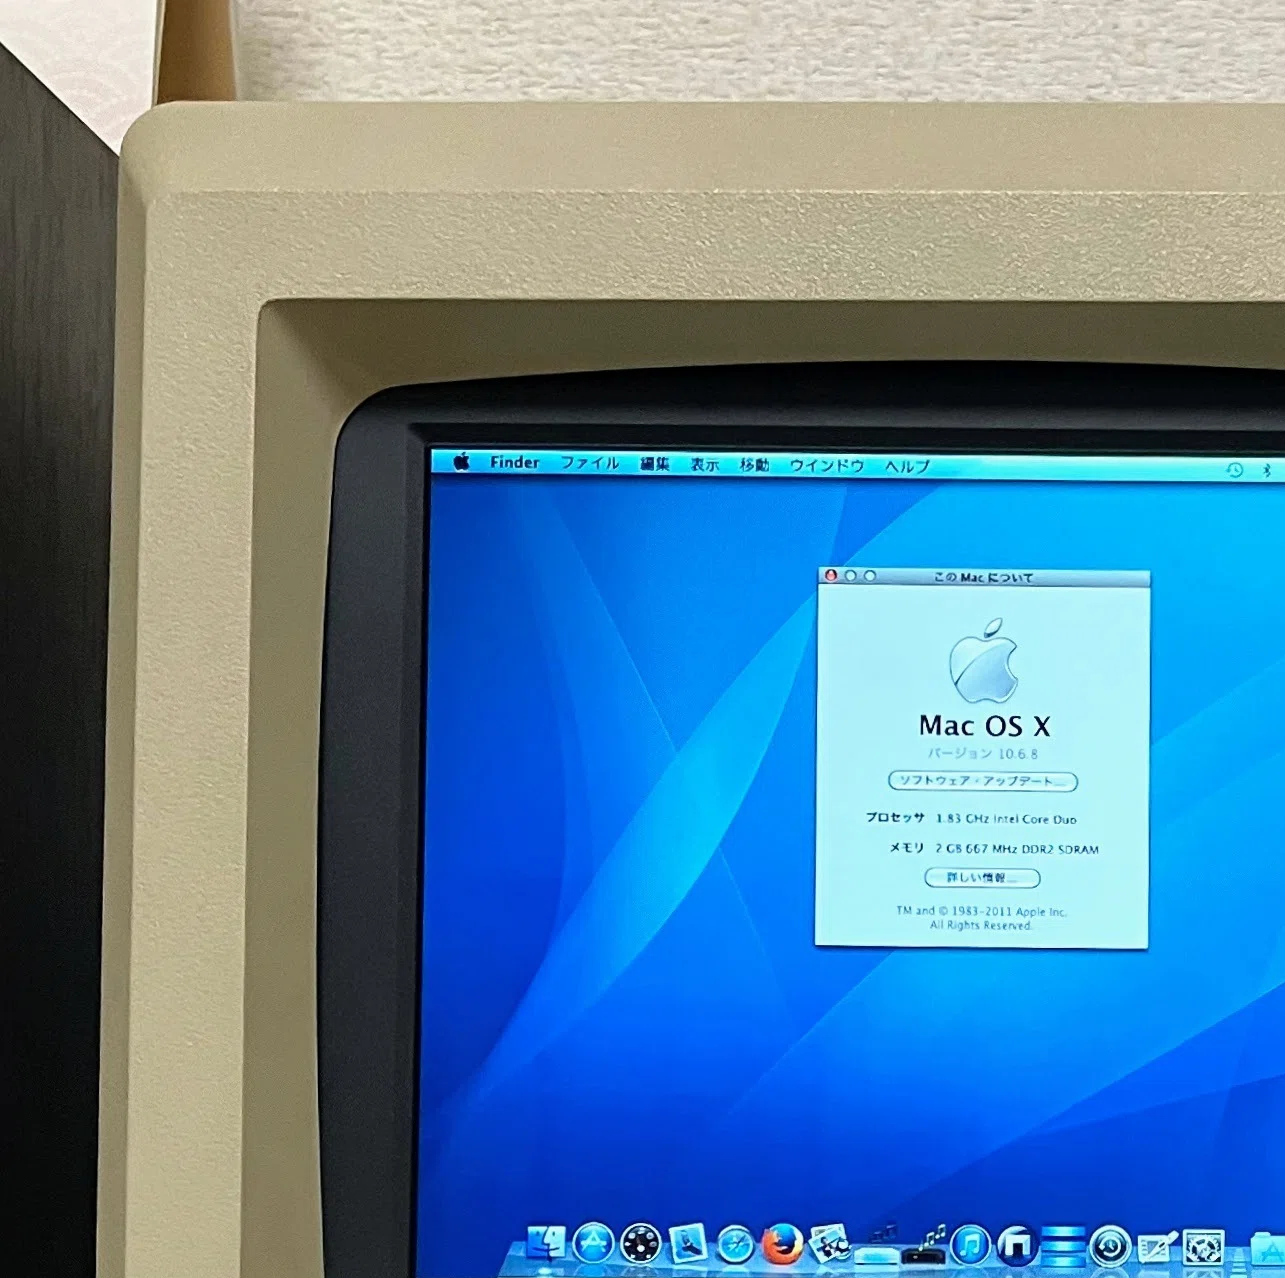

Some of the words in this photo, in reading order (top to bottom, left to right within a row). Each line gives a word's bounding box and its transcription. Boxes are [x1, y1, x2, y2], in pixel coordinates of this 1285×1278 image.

[490, 456, 539, 469] Finder
[562, 457, 619, 470] ファイル
[640, 456, 670, 471] 編集
[691, 457, 720, 471] 表示
[740, 457, 770, 472] 移動
[790, 458, 864, 473] ウインドウ
[885, 459, 930, 474] ヘルプ
[961, 572, 984, 583] Mac
[989, 573, 1034, 583] について
[920, 715, 974, 736] Mac
[986, 716, 1022, 737] OS
[1034, 716, 1051, 737] X
[928, 748, 992, 759] バージョン
[999, 748, 1038, 760] 10.6.8
[866, 812, 924, 823] プロセッサ
[936, 814, 961, 824] 1.83
[966, 814, 989, 824] GHz
[993, 814, 1018, 824] Intel
[1023, 814, 1049, 825] Core
[1054, 815, 1077, 825] Duo
[890, 842, 924, 853] メモリ
[936, 844, 941, 854] 2
[947, 844, 961, 854] GB
[966, 844, 987, 854] 667
[993, 845, 1017, 854] MHz
[1022, 845, 1054, 855] DDR2
[1059, 845, 1099, 855] SDRAM
[897, 906, 912, 916] TM
[916, 906, 935, 916] and
[953, 906, 1012, 917] 1983-2011
[1016, 907, 1046, 919] Apple
[1050, 907, 1068, 917] Inc.
[930, 920, 943, 930] All
[947, 920, 980, 932] Rights
[984, 921, 1033, 931] Reserved.
